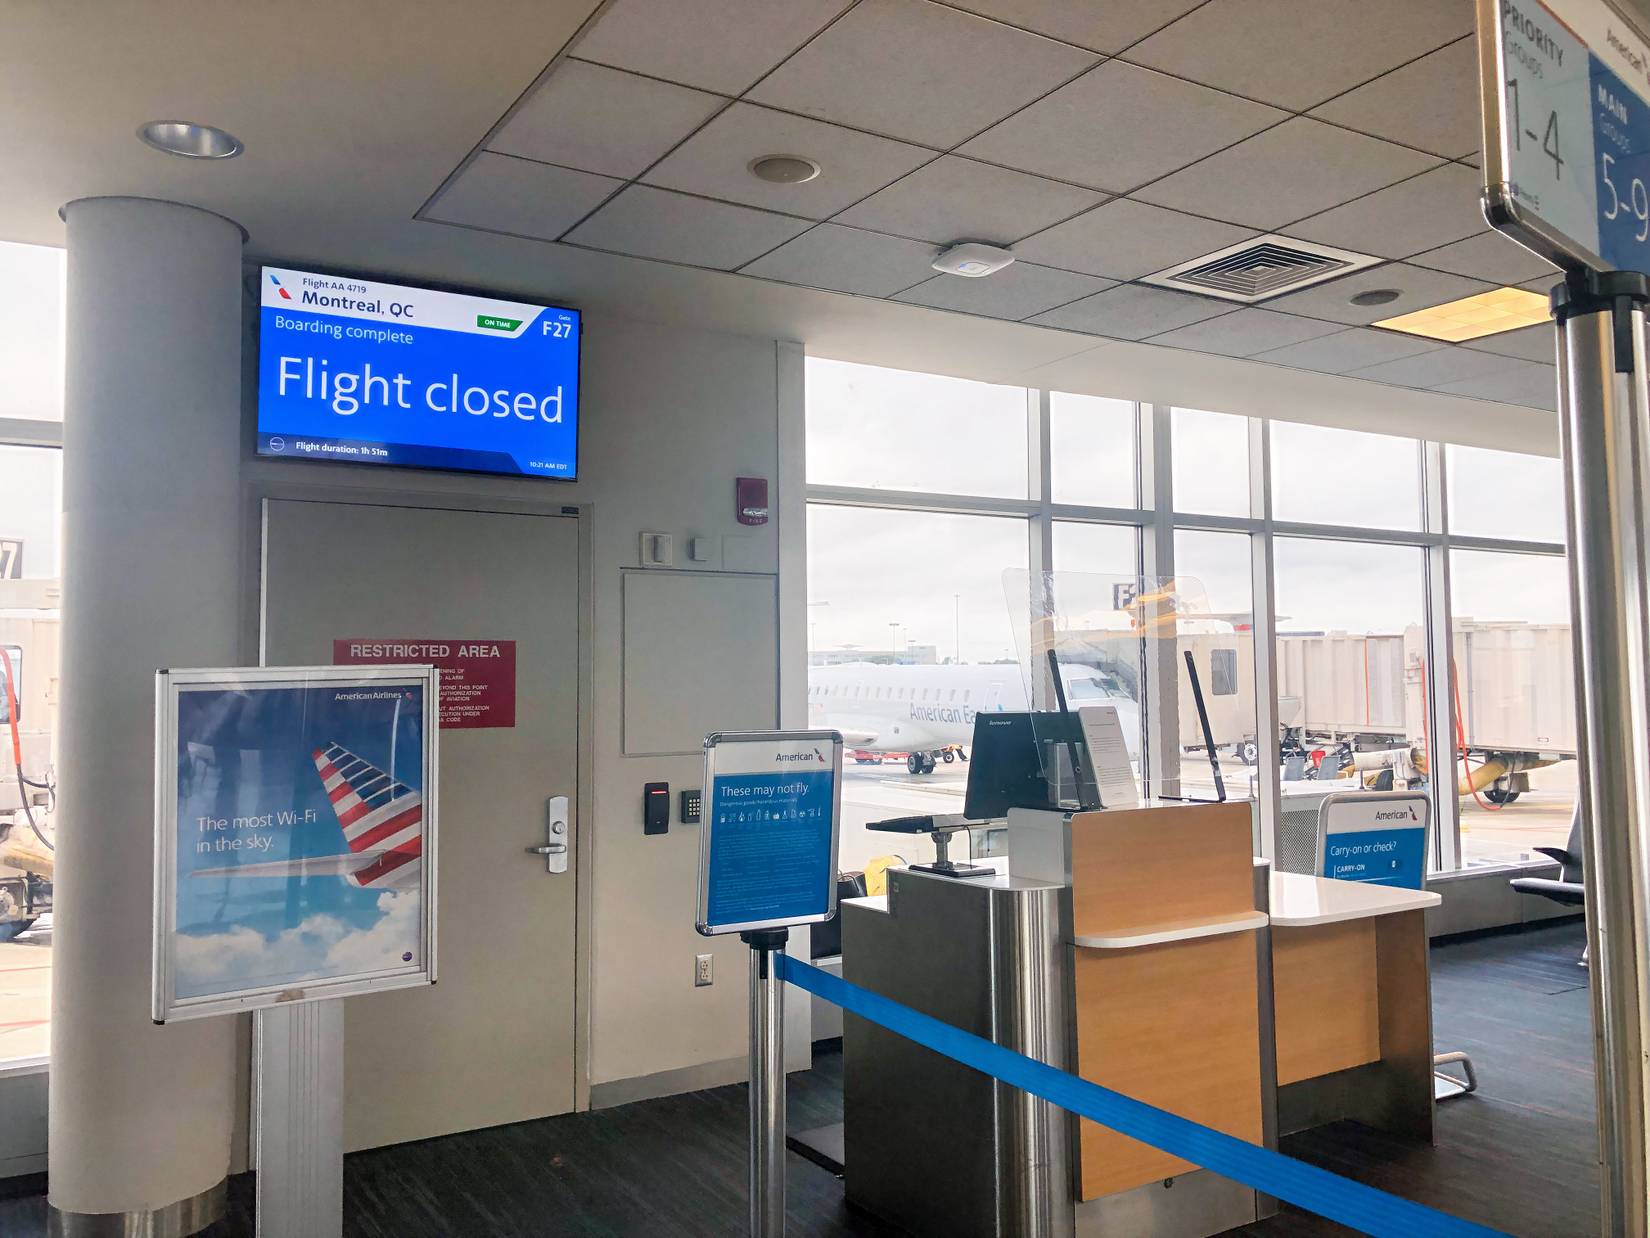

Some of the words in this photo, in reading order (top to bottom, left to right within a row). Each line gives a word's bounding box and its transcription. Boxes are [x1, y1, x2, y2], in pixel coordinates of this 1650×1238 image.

[1502, 0, 1564, 67] PRIORITY
[1597, 84, 1628, 125] MAIN
[1506, 78, 1564, 181] 1-4
[1602, 152, 1650, 243] 5-9
[302, 277, 329, 289] Flight
[330, 281, 345, 291] AA
[347, 284, 367, 294] 4719
[301, 290, 385, 316] Montreal,
[389, 302, 414, 318] QC
[275, 315, 342, 339] Boarding
[346, 324, 413, 345] complete
[484, 319, 496, 328] ON
[497, 320, 511, 329] TIME
[542, 321, 571, 339] F27
[279, 355, 411, 416] Flight
[425, 373, 563, 423] closed
[295, 441, 319, 453] Flight
[320, 442, 359, 455] duration:
[360, 445, 370, 455] 1h
[371, 447, 388, 457] 51m
[545, 462, 555, 470] AM
[350, 644, 450, 658] RESTRICTED
[457, 644, 501, 658] AREA
[909, 702, 962, 724] American
[775, 751, 813, 762] American
[720, 786, 751, 797] These
[753, 785, 776, 798] may
[777, 784, 795, 794] not
[196, 816, 227, 833] The
[232, 812, 274, 828] most
[276, 808, 316, 825] Wi-Fi
[1375, 810, 1408, 821] American
[196, 839, 212, 854] in
[215, 836, 242, 852] the
[246, 833, 275, 853] sky.
[1330, 844, 1362, 858] Carry-on
[1363, 844, 1372, 854] or
[1373, 841, 1397, 852] check?
[1336, 864, 1366, 873] CARRY-ON
